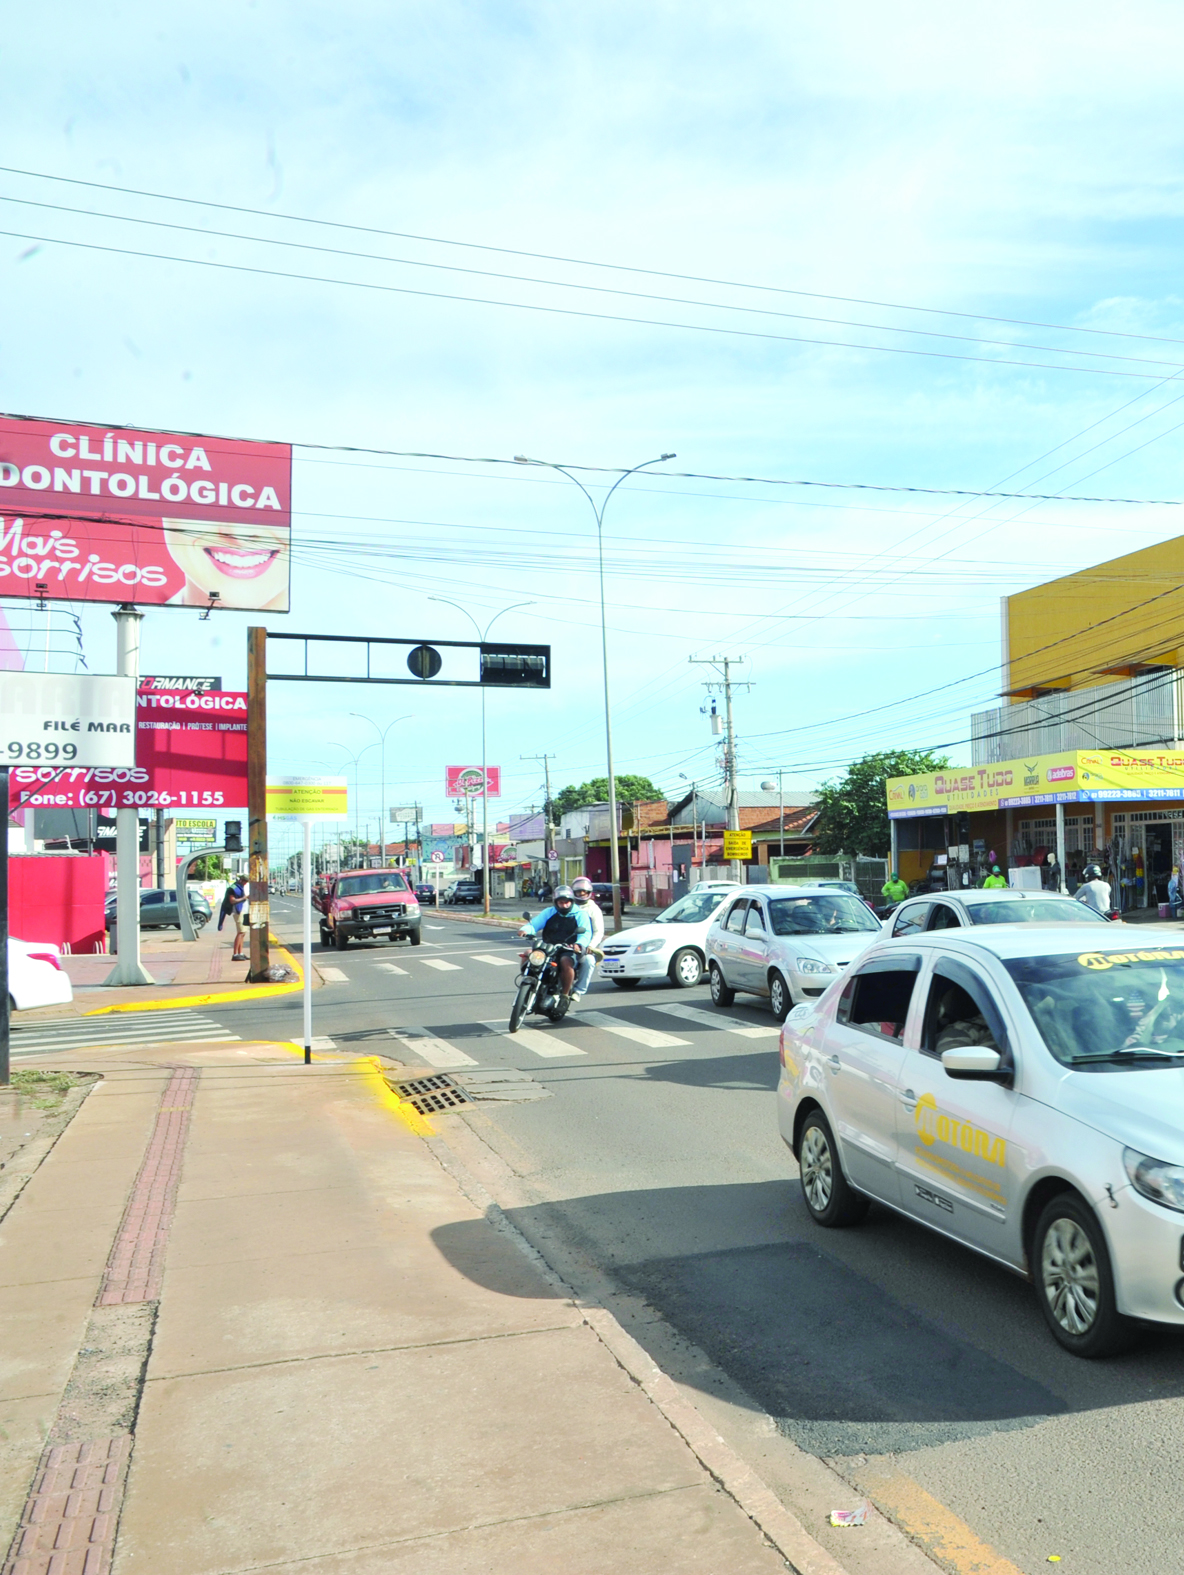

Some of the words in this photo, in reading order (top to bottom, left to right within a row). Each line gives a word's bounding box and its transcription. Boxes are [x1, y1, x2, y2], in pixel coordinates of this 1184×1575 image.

[49, 432, 212, 471] CLÍNICA
[0, 462, 282, 510] DONTOLÓGICA
[43, 718, 81, 732] FILÉ
[87, 722, 131, 733] MAR
[138, 721, 181, 731] RESTAURAÇÃO
[187, 721, 213, 731] PRÓTESE
[78, 789, 117, 806] (67)
[122, 790, 225, 805] 3026-1155
[947, 788, 999, 802] UTILIDADES
